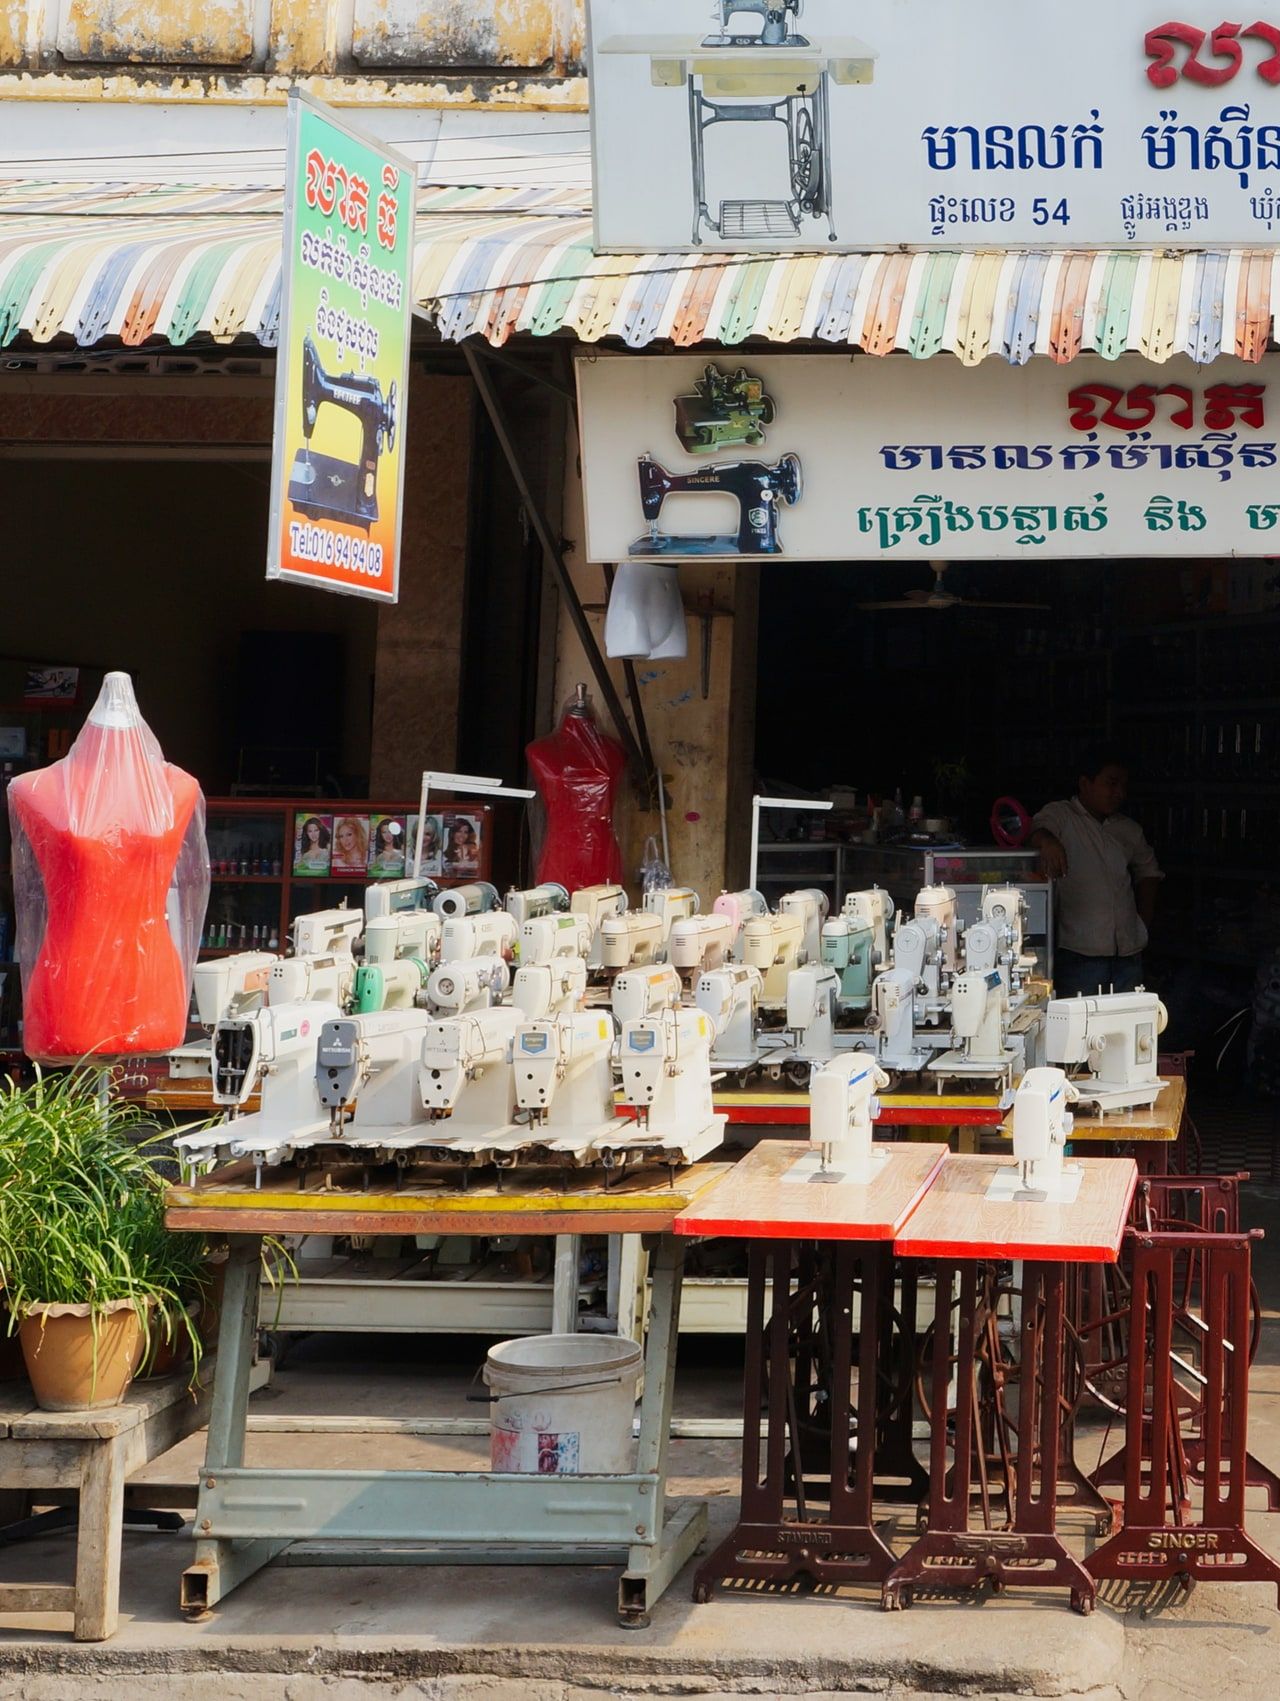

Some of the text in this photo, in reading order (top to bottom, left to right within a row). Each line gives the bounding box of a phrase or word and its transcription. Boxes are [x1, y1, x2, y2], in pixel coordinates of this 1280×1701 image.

[921, 109, 1104, 171] មានលក់
[928, 194, 1015, 236] ផ្ទះលេខ
[1031, 198, 1071, 227] 54
[1143, 495, 1208, 531] និង
[290, 521, 383, 577] Tel:016 94 94 08
[776, 1531, 832, 1545] STANDARD
[1148, 1532, 1219, 1550] SINGER
